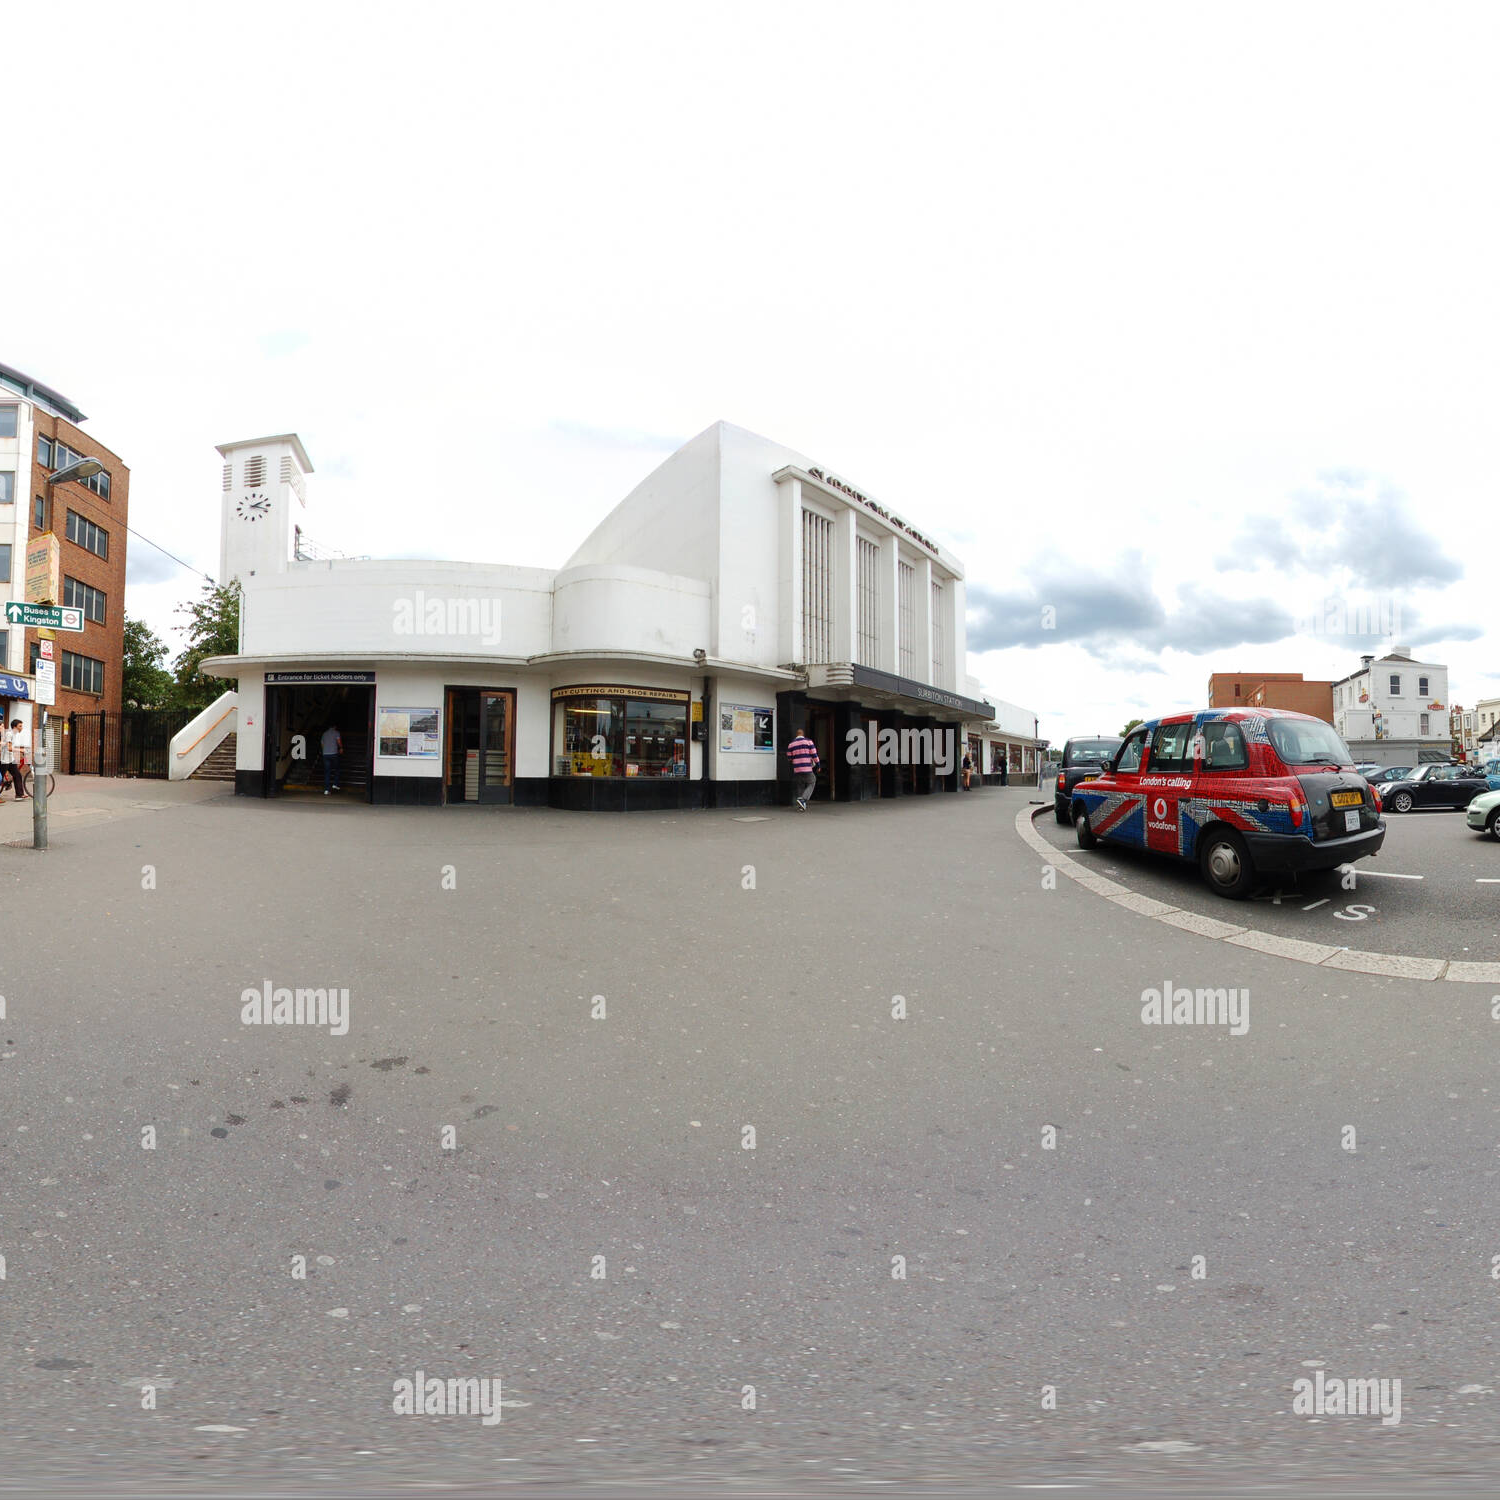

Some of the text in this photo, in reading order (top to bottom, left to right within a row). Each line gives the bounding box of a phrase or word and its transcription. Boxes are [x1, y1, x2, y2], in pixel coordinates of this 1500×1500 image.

[24, 606, 60, 616] Buses to
[24, 615, 59, 625] Kingston
[1140, 777, 1192, 790] London's calling
[1148, 821, 1177, 831] vodafone
